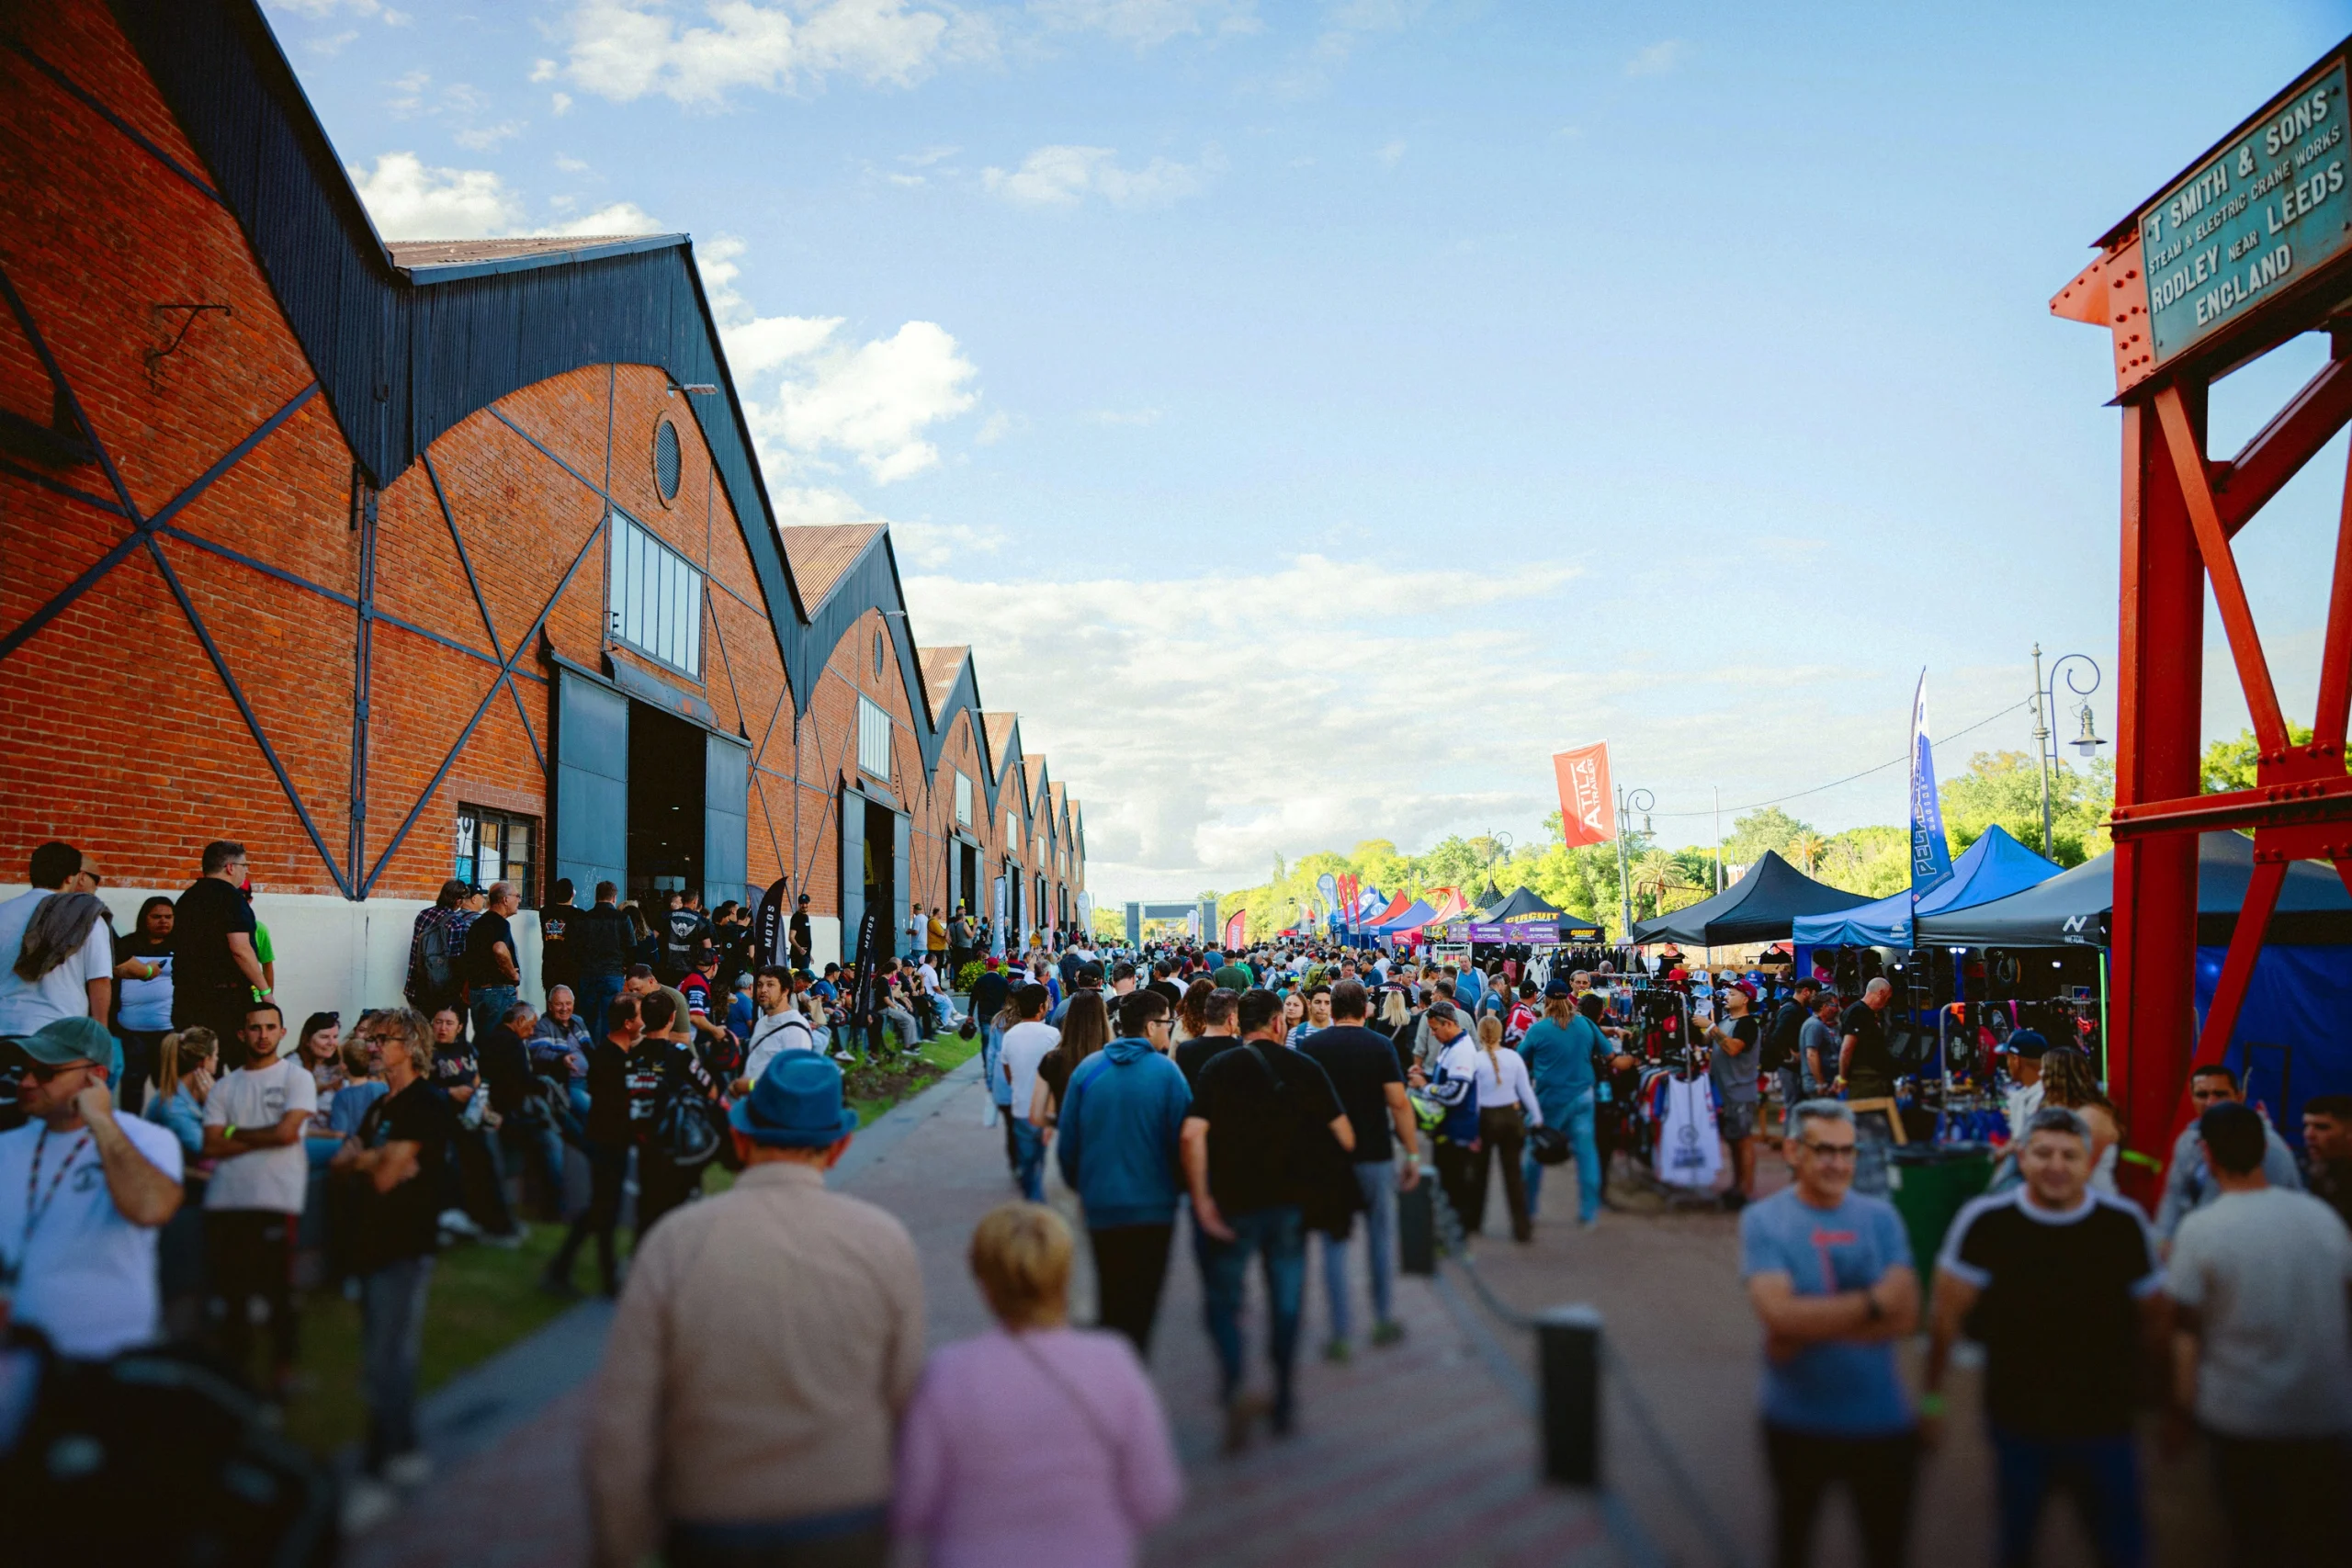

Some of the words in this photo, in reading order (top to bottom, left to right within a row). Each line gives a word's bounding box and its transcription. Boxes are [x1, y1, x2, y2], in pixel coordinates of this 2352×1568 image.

[2149, 239, 2183, 275] STEAM
[2185, 235, 2193, 249] &
[2196, 192, 2247, 243] ELECTRIC
[2251, 160, 2290, 200] CRANE
[2294, 125, 2342, 169] WORKS
[2151, 213, 2163, 243] T
[2170, 164, 2229, 229] SMITH
[2237, 146, 2255, 178] &
[2266, 90, 2328, 156] SONS
[2151, 243, 2220, 314] RODLEY
[2228, 231, 2259, 263] NEAR
[2266, 161, 2344, 235] LEEDS
[2195, 243, 2292, 327] ENGLAND
[1576, 760, 1603, 829] ATILA
[1587, 758, 1600, 806] TRAILER
[764, 904, 775, 948] MOTOS
[865, 915, 876, 950] MOTOS
[1505, 911, 1560, 924] CIRCUIT
